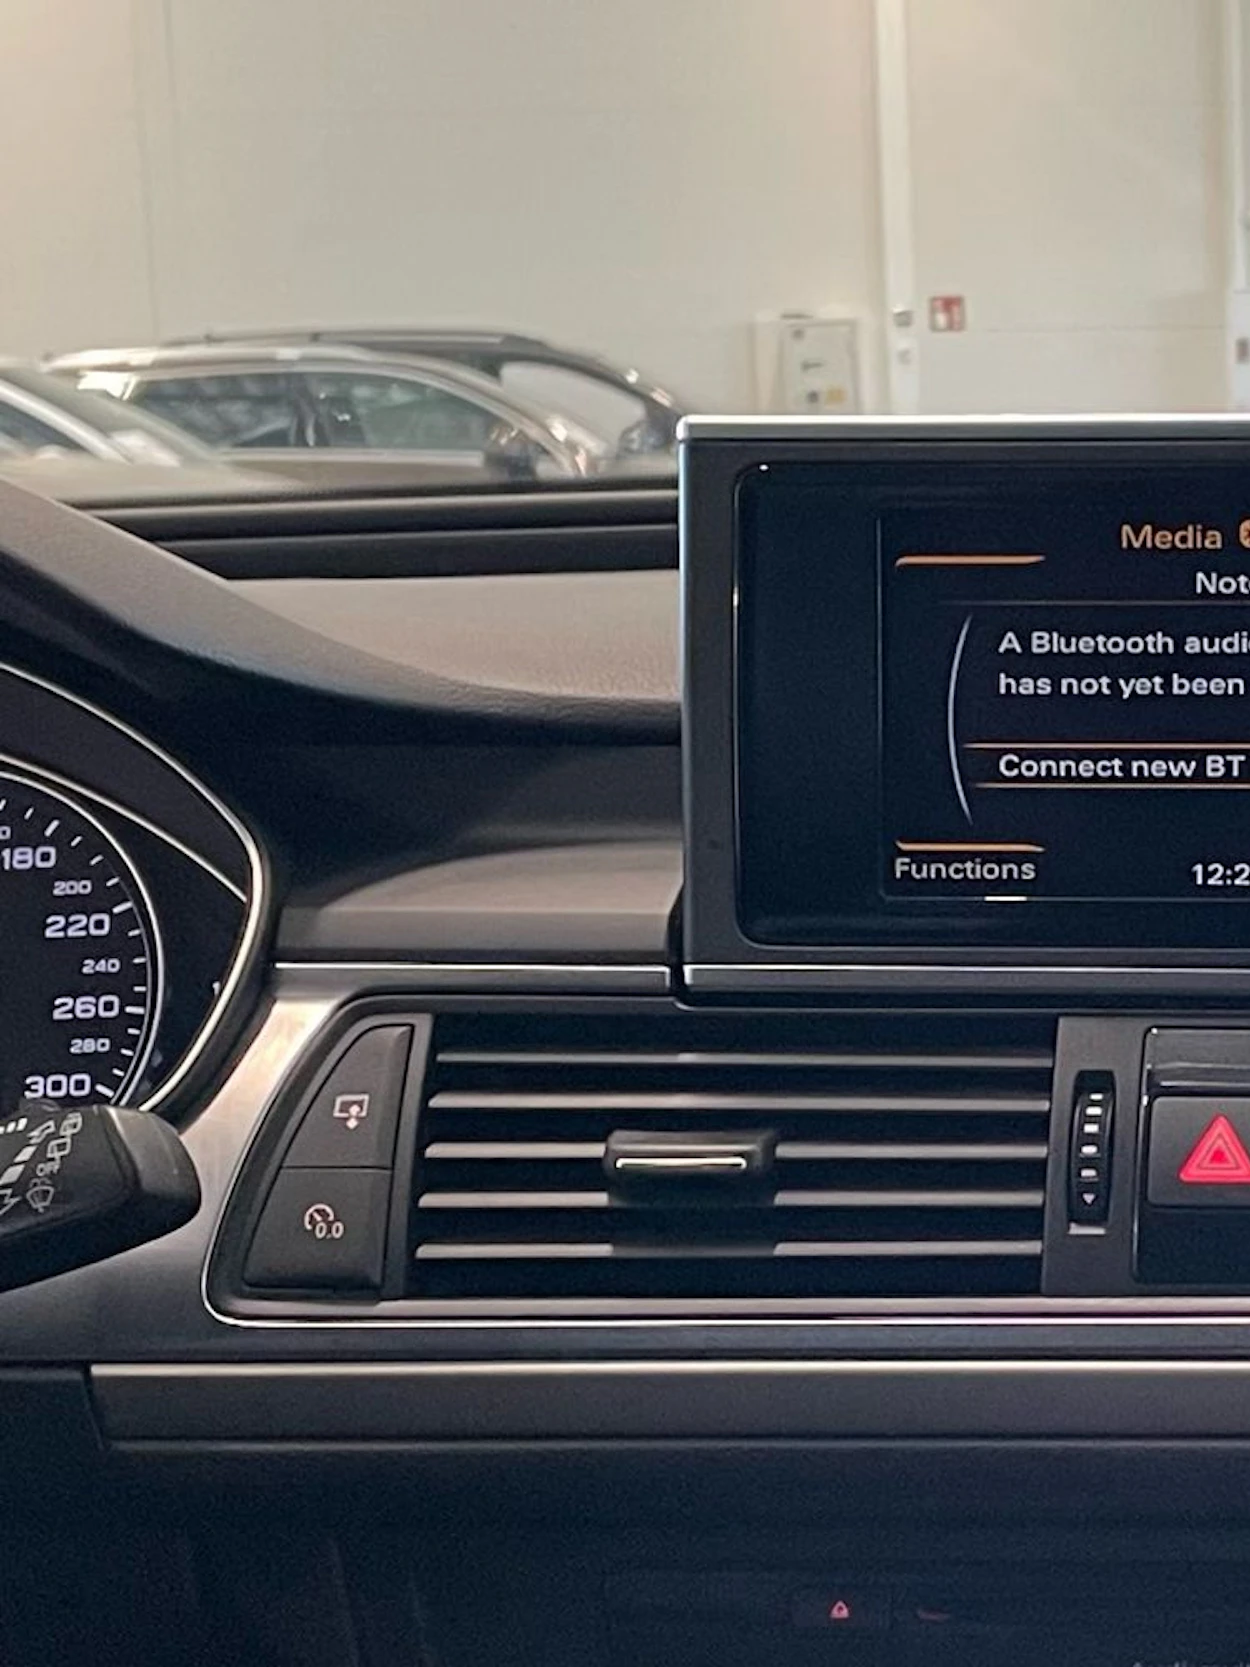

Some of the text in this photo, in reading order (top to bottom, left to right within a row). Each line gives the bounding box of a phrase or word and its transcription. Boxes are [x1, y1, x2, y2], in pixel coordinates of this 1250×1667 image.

[1122, 525, 1221, 549] Media
[999, 632, 1022, 653] A
[1032, 632, 1174, 653] Bluetooth
[1000, 673, 1051, 694] has
[1061, 676, 1111, 694] not
[1119, 676, 1164, 699] yet
[1173, 673, 1244, 694] been
[1000, 754, 1123, 777] Connect
[1132, 760, 1196, 777] new
[1206, 755, 1246, 777] BT
[2, 847, 56, 869] 180
[896, 858, 1035, 879] Functions
[53, 880, 92, 895] 200
[45, 914, 110, 937] 220
[82, 959, 120, 973] 240
[53, 995, 119, 1019] 260
[70, 1038, 110, 1053] 280
[25, 1074, 91, 1099] 300
[315, 1222, 344, 1239] 0.0
